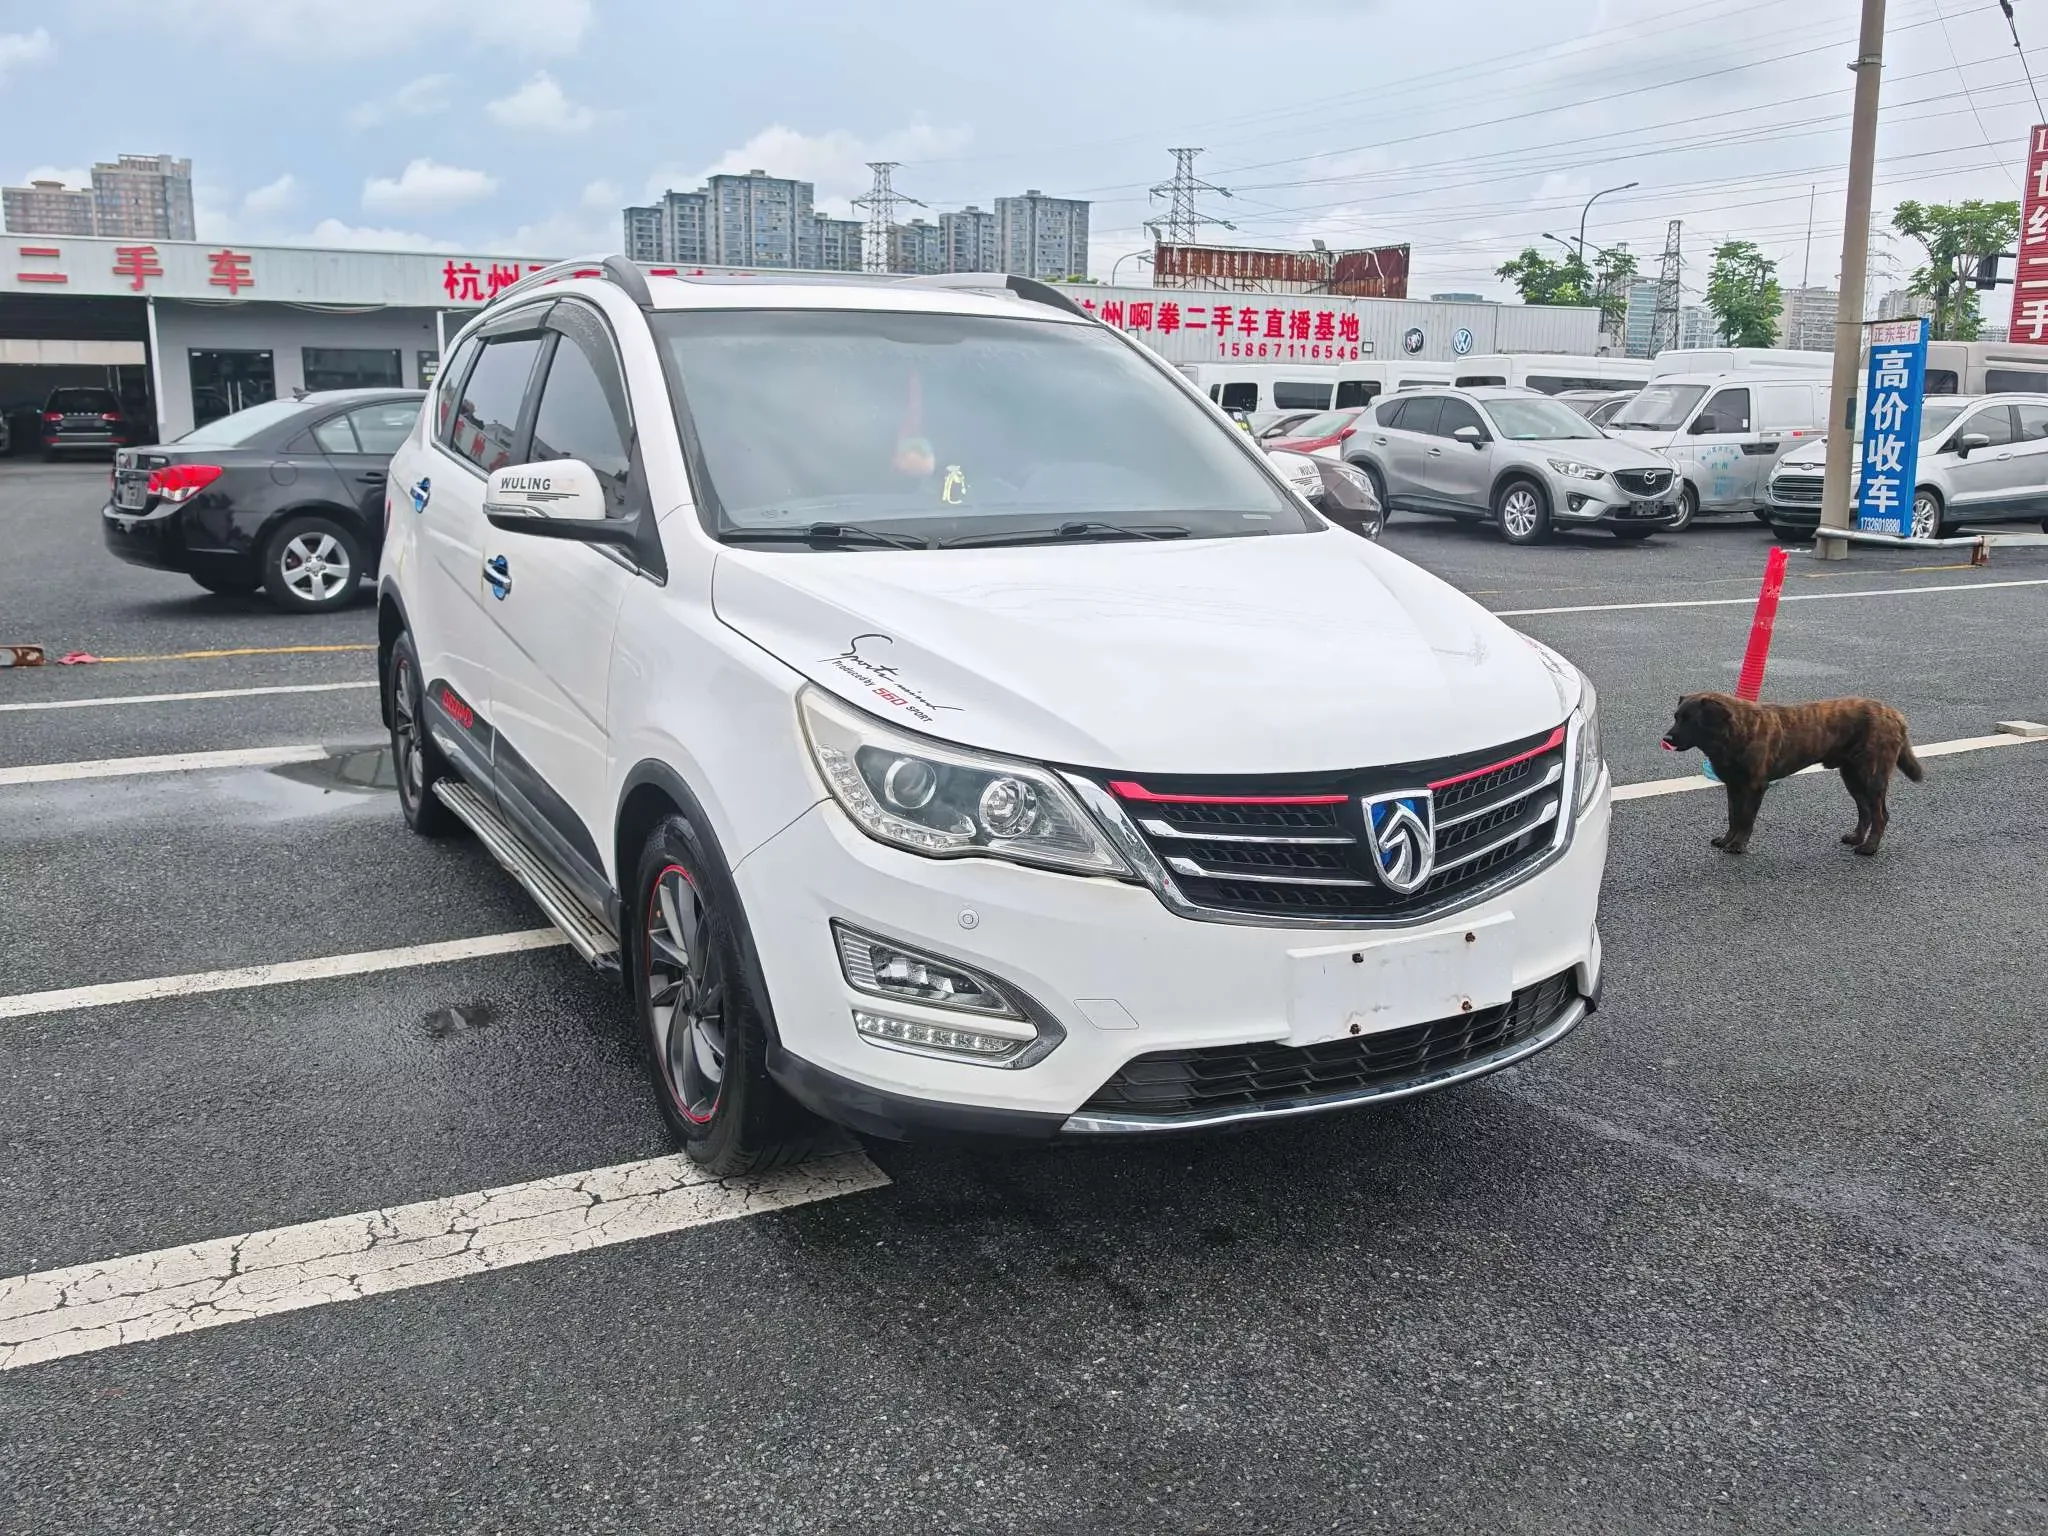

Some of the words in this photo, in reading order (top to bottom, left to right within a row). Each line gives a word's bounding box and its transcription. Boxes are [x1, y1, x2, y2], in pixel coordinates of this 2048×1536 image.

[17, 246, 254, 295] 二手车
[1872, 325, 1918, 343] 正东车行
[1219, 342, 1359, 360] 15867116546
[1864, 350, 1912, 513] 高价收车
[501, 478, 551, 490] WULING
[872, 687, 909, 706] 560
[906, 706, 933, 723] SPORT
